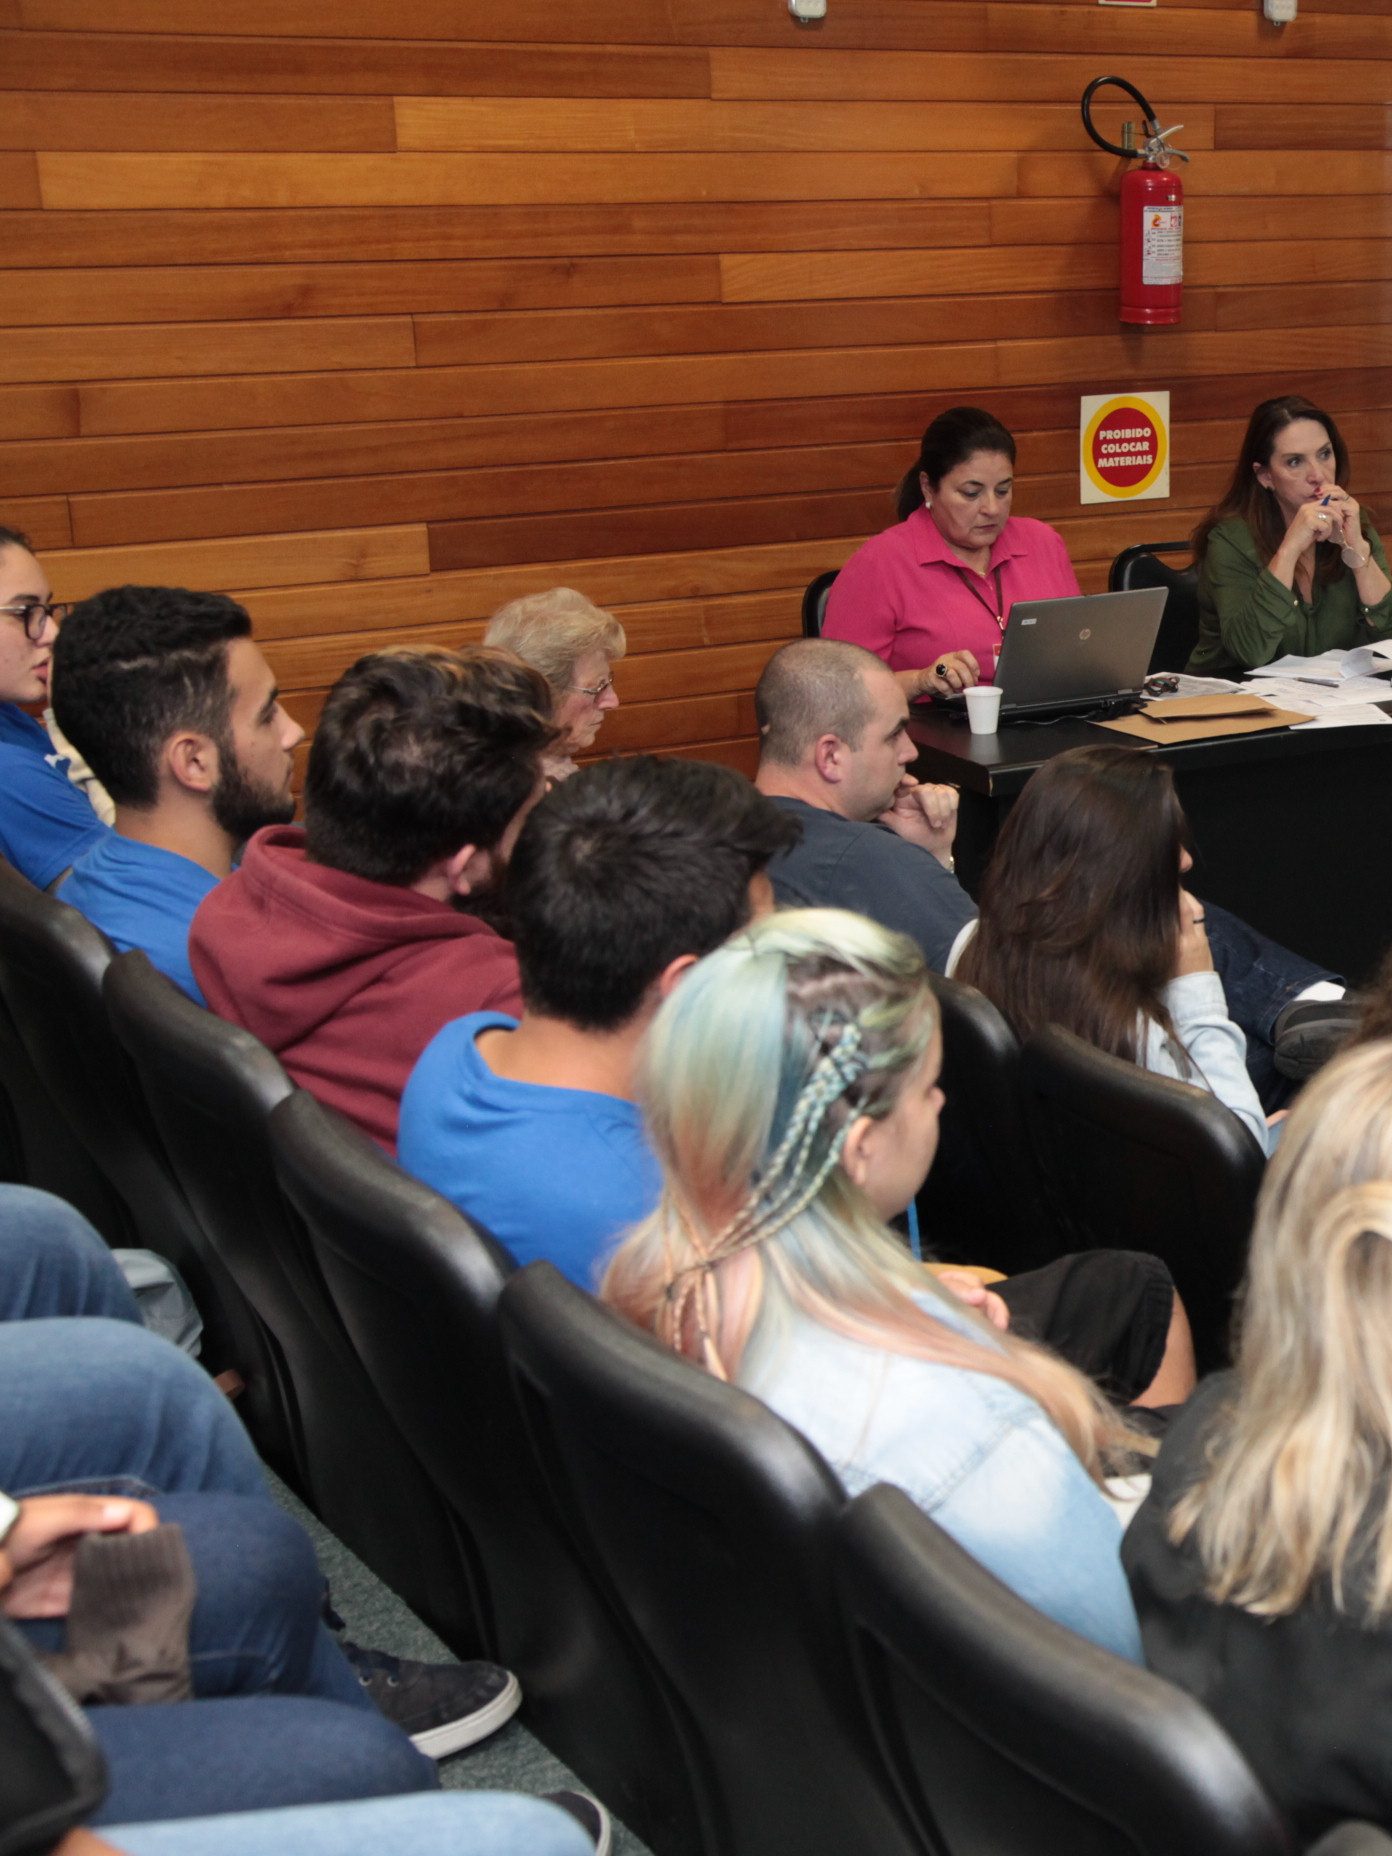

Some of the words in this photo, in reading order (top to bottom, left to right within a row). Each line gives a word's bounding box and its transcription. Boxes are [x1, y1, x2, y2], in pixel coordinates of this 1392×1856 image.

[1099, 427, 1152, 440] PROIBIDO
[1101, 442, 1149, 453] COLOCAR
[1098, 455, 1153, 467] MATERIAIS
